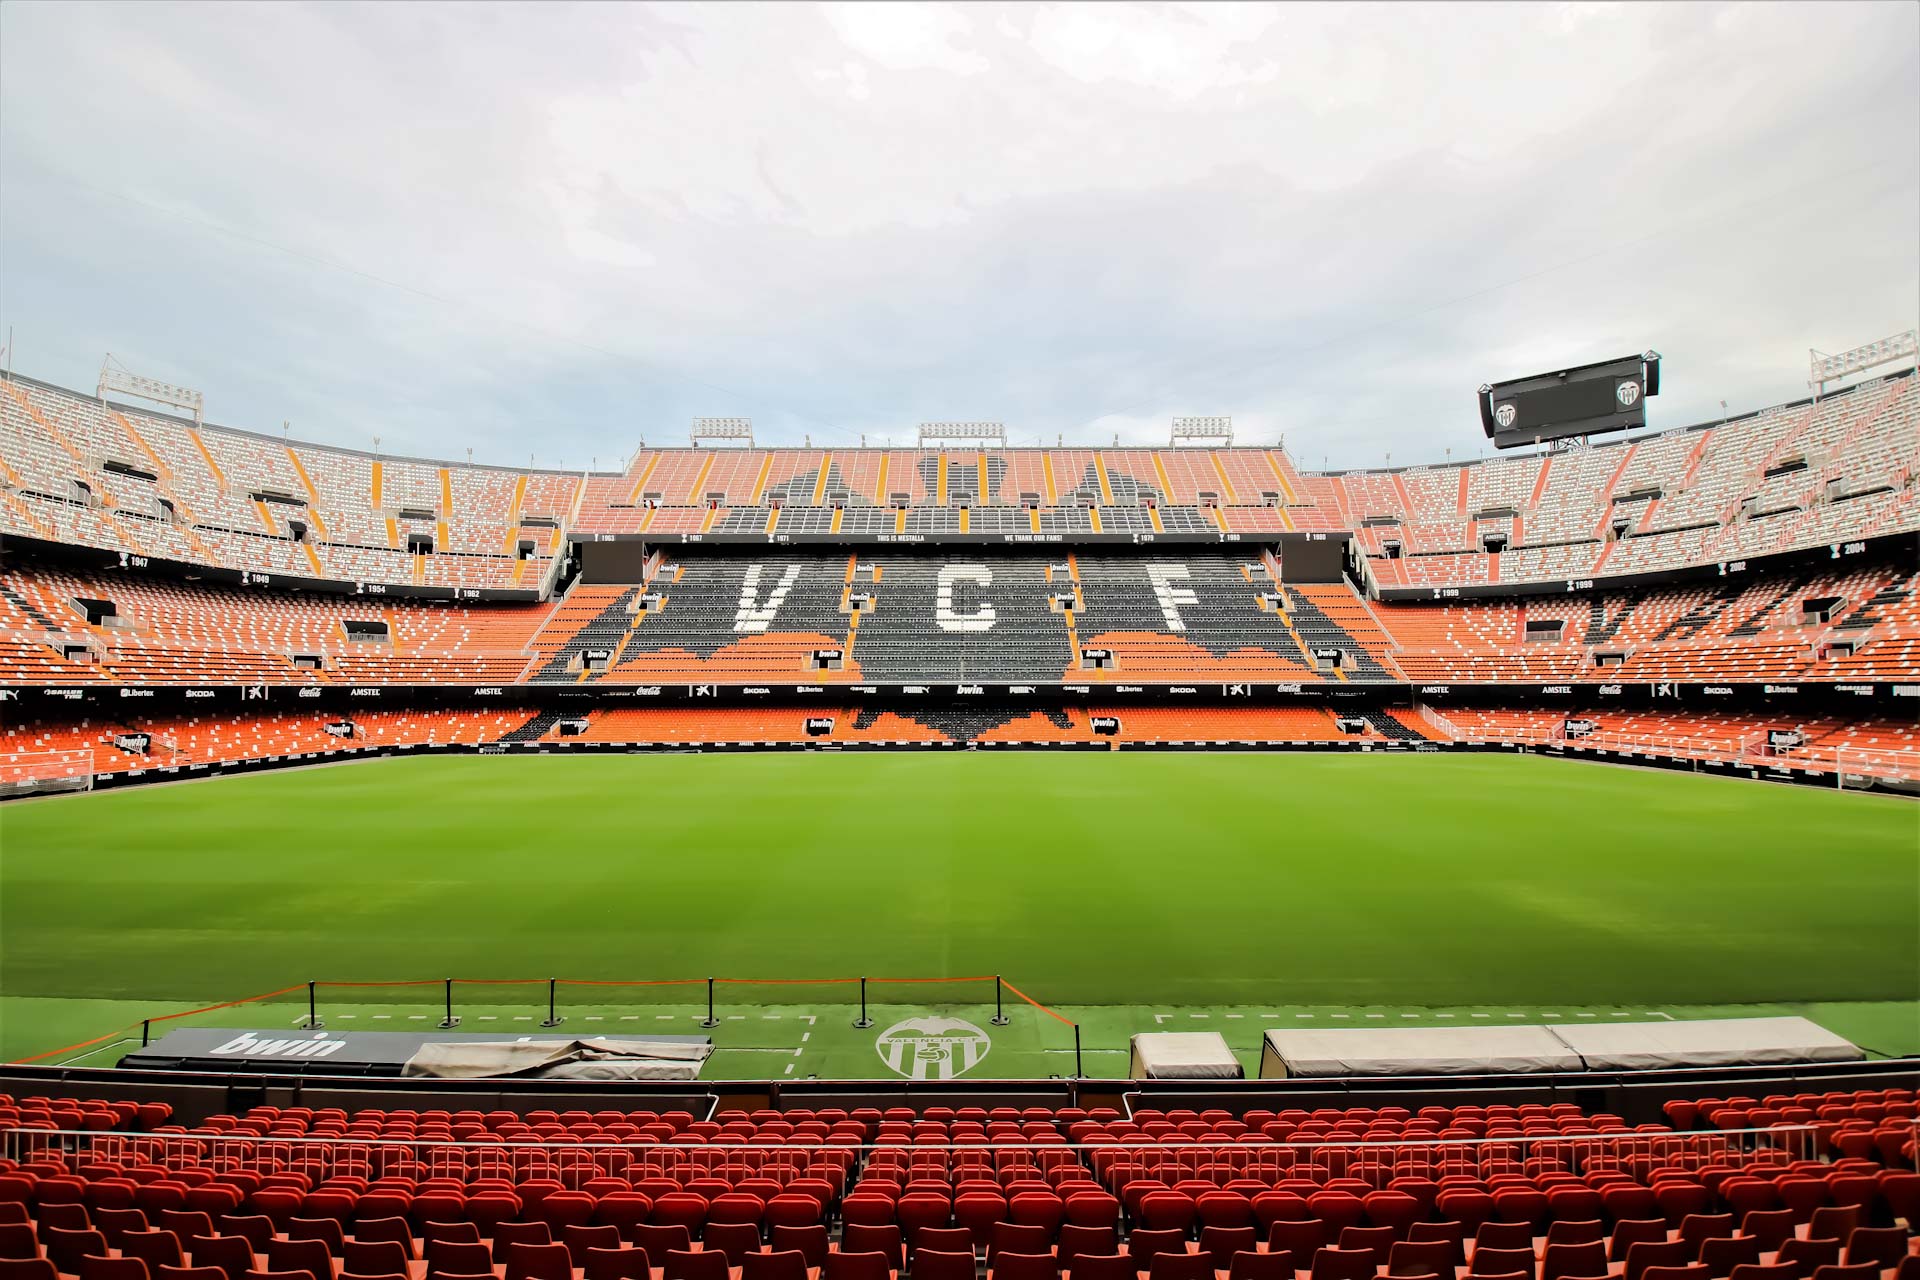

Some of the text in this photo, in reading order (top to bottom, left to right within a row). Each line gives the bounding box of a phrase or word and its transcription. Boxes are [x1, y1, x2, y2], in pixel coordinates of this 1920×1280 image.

[1844, 542, 1866, 554] 2004
[131, 556, 148, 567] 1947
[1729, 561, 1746, 572] 2002
[252, 574, 270, 583] 1949
[368, 585, 386, 593] 1954
[1575, 580, 1593, 589] 1999
[936, 564, 996, 630] C
[1146, 564, 1199, 630] F
[1442, 589, 1459, 597] 1999
[587, 650, 607, 658] bwin
[1317, 649, 1338, 657] bwin
[128, 689, 154, 697] Libertex
[186, 689, 215, 698] ŠKODA
[350, 688, 381, 696] AMSTEL
[743, 686, 770, 694] ŠKODA
[1421, 686, 1449, 694] AMSTEL
[1542, 686, 1572, 694] AMSTEL
[1703, 686, 1733, 694] ŠKODA
[1771, 685, 1798, 693] Libertex
[810, 719, 831, 728] bwin
[1093, 718, 1115, 727] bwin
[1567, 721, 1590, 730] bwin
[328, 723, 351, 734] bwin
[121, 735, 148, 748] bwin
[1771, 731, 1799, 744] bwin
[209, 1032, 346, 1057] bwin
